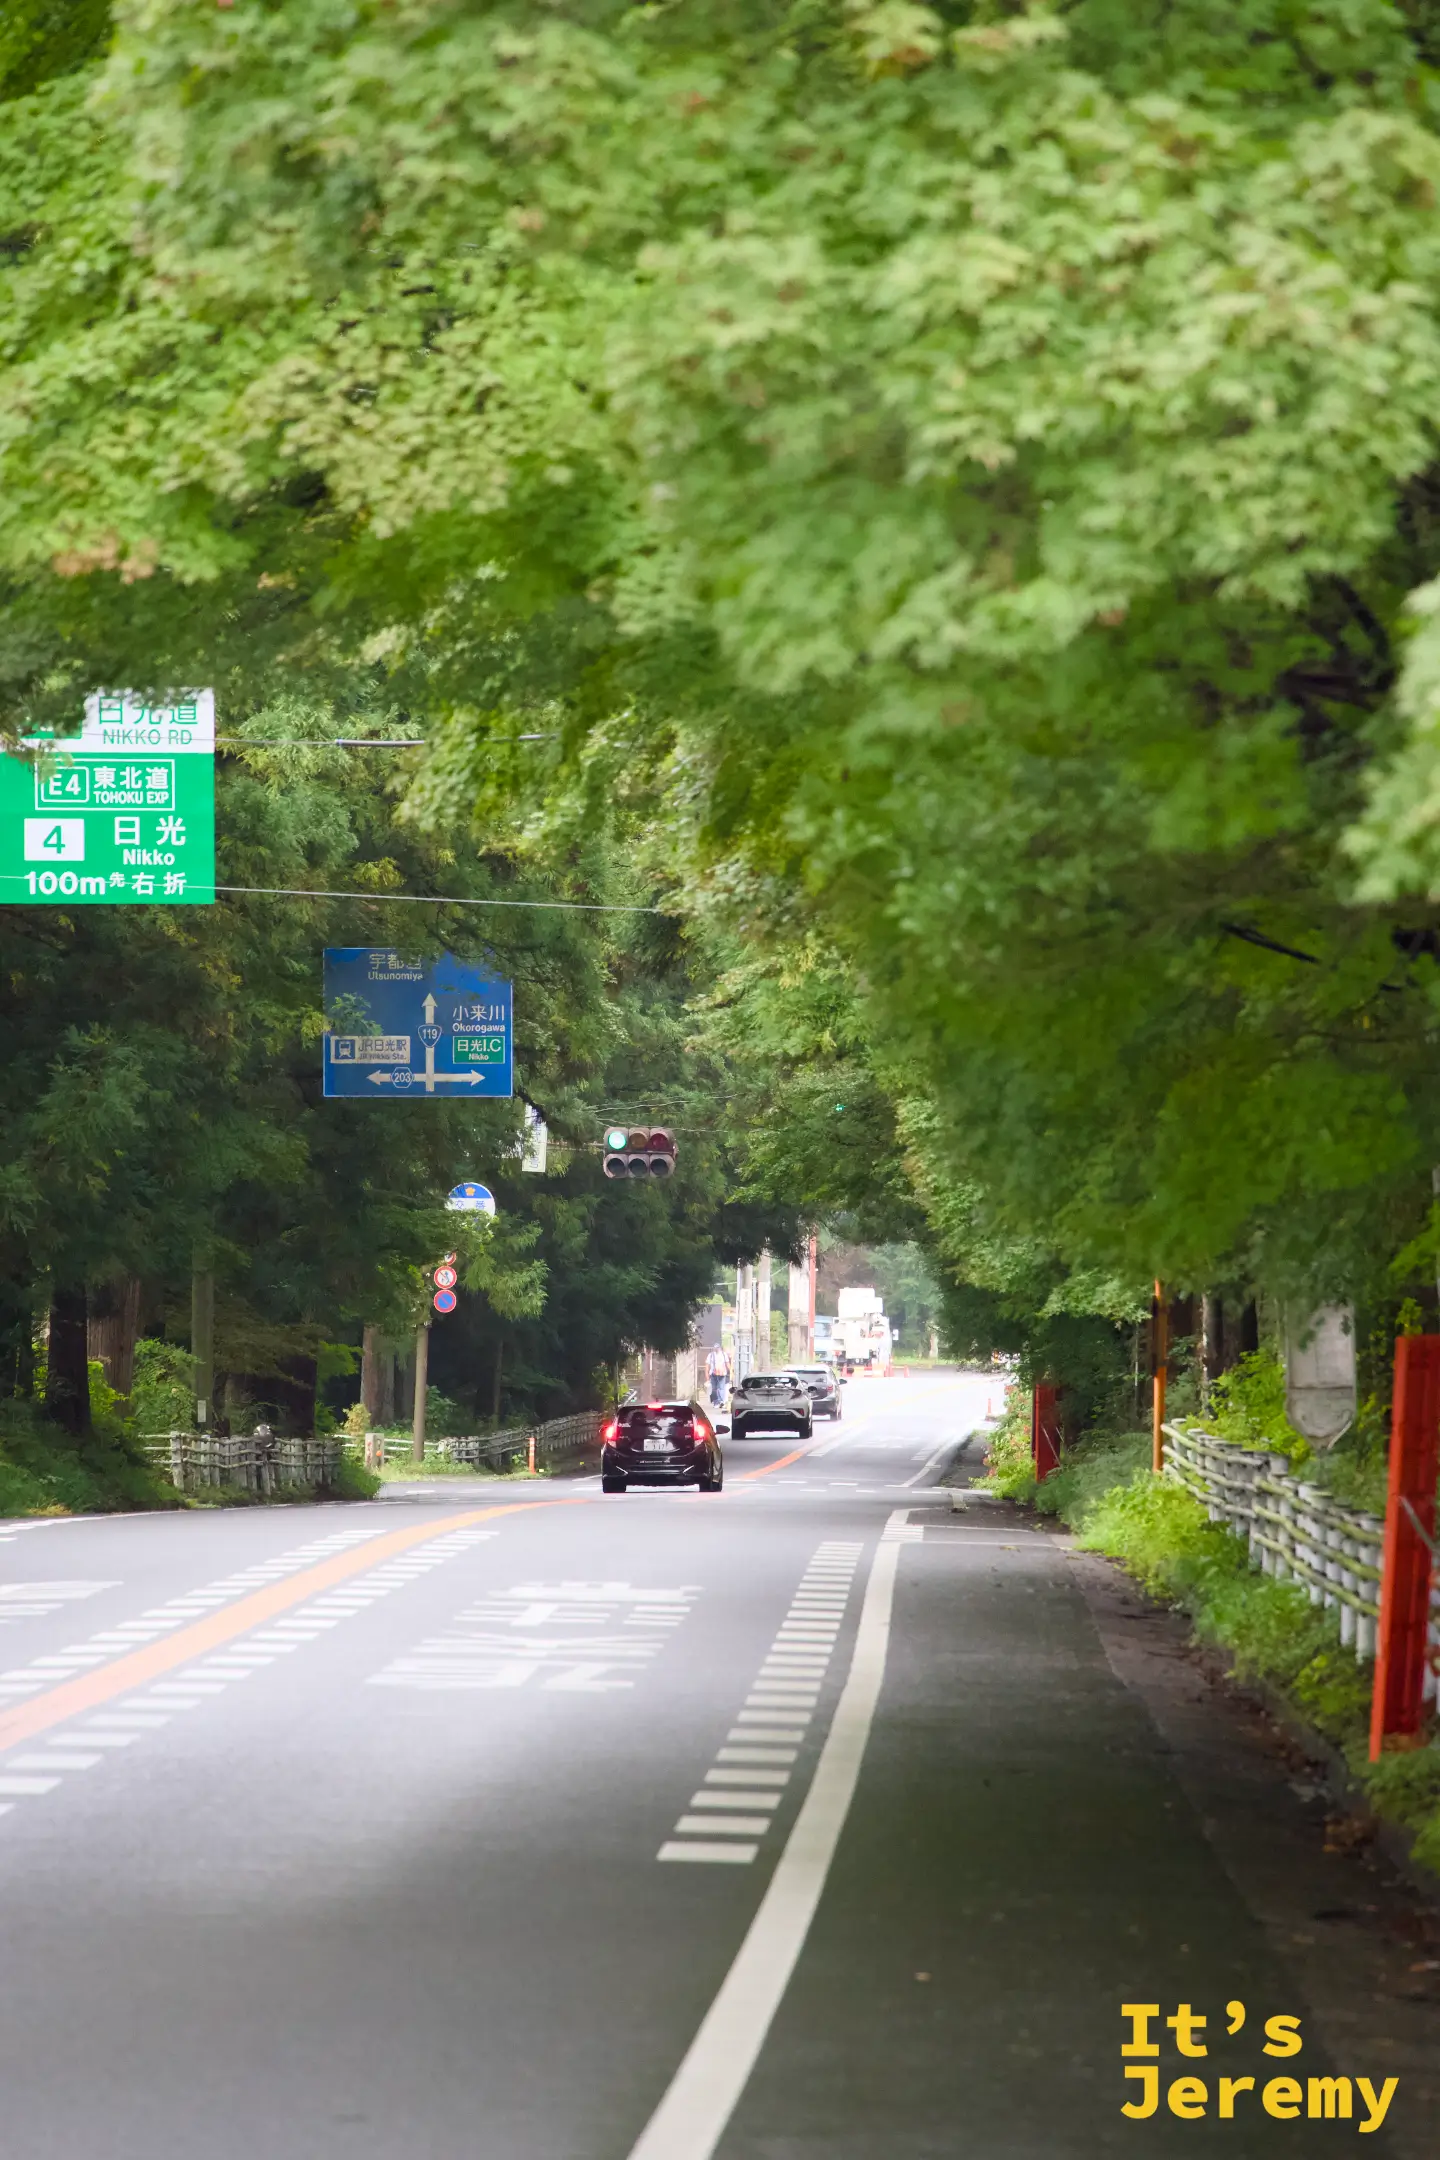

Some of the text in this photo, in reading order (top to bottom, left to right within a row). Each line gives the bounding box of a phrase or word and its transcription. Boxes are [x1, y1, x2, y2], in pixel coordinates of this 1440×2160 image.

[103, 729, 193, 745] NIKKO RD
[49, 773, 81, 795] E4
[93, 766, 169, 789] 東北道
[93, 791, 169, 804] TOHOKU EXP
[114, 815, 187, 846] 日光
[43, 825, 66, 855] 4
[123, 848, 176, 866] Nikko
[452, 1004, 505, 1022] 小来川
[422, 1028, 438, 1040] 119
[452, 1022, 506, 1034] Okorogawa
[358, 1038, 407, 1052] JR日光駅
[468, 1053, 490, 1061] Nikko
[393, 1072, 411, 1083] 203
